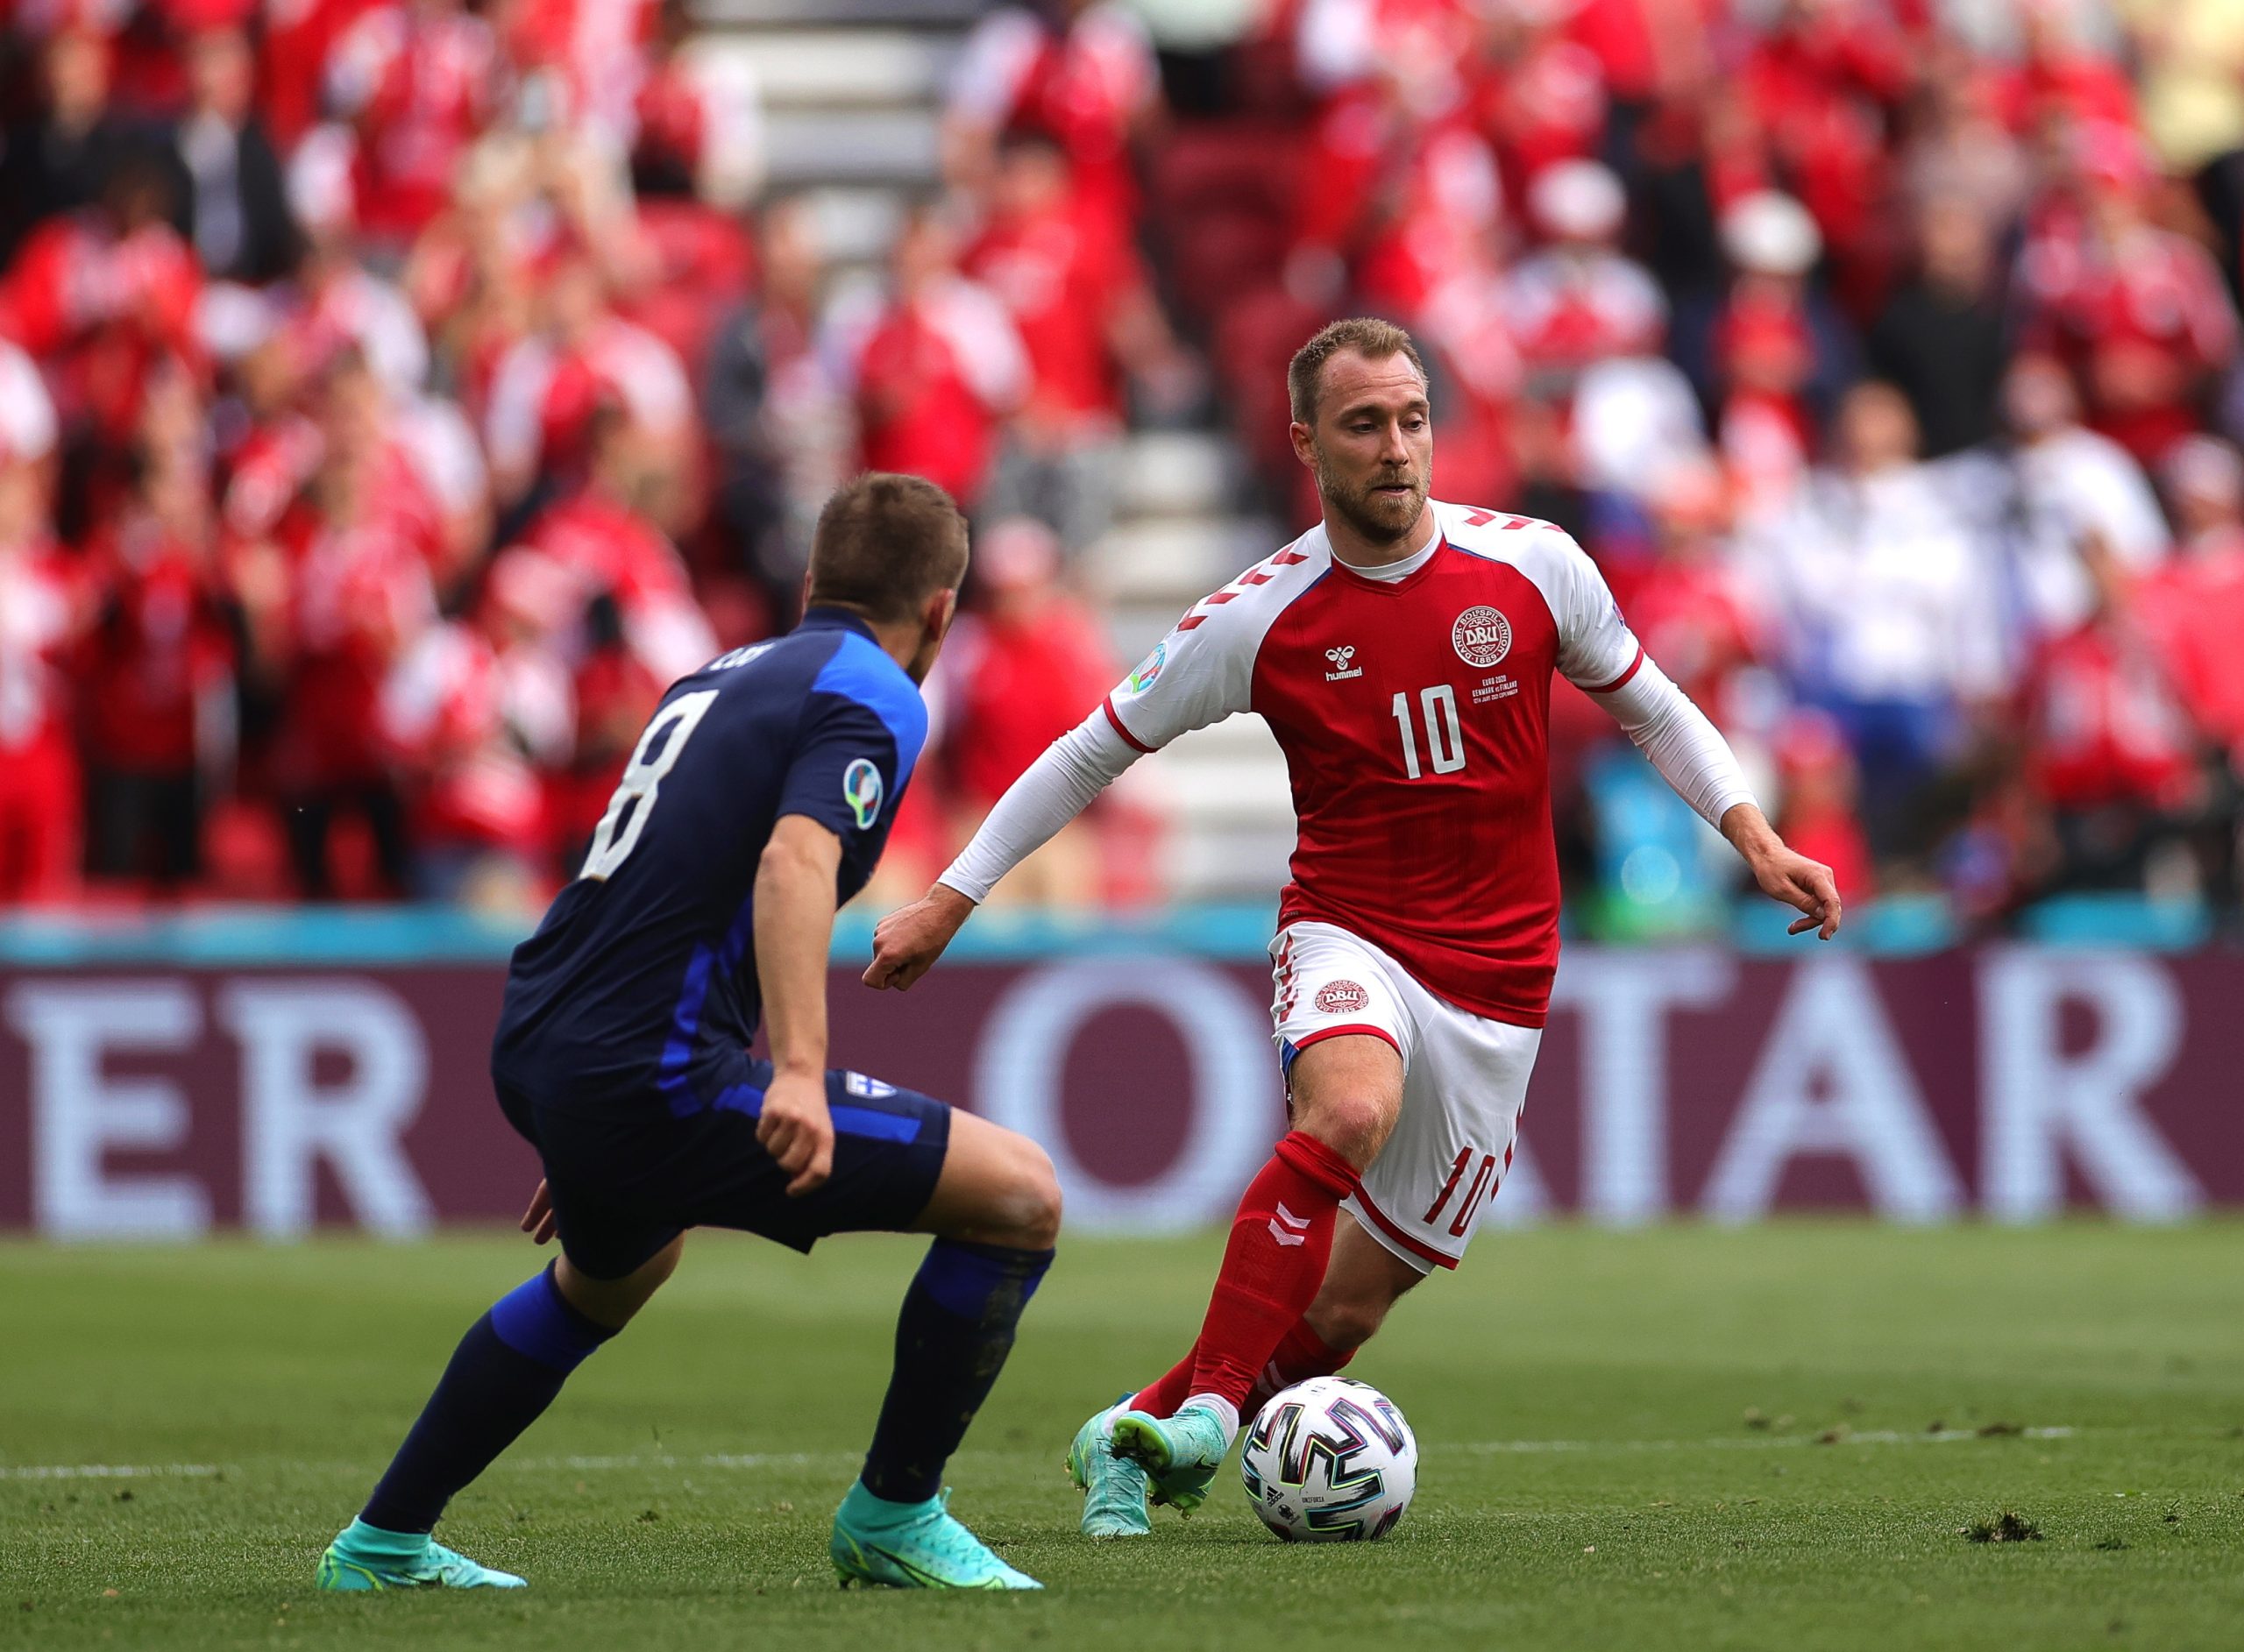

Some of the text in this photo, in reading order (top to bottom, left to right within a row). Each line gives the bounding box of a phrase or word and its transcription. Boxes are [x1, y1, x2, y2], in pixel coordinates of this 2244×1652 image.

[1465, 626, 1499, 646] DBU
[1498, 621, 1509, 654] UNION
[1325, 666, 1363, 682] hummel
[1474, 654, 1497, 663] 1889
[1472, 686, 1495, 697] DENMARK
[1392, 684, 1466, 779] 10
[579, 689, 720, 883] 8
[1325, 990, 1360, 1003] DBU
[971, 951, 2211, 1229] QTAR
[4, 979, 436, 1243] ER
[1421, 1145, 1495, 1237] 10
